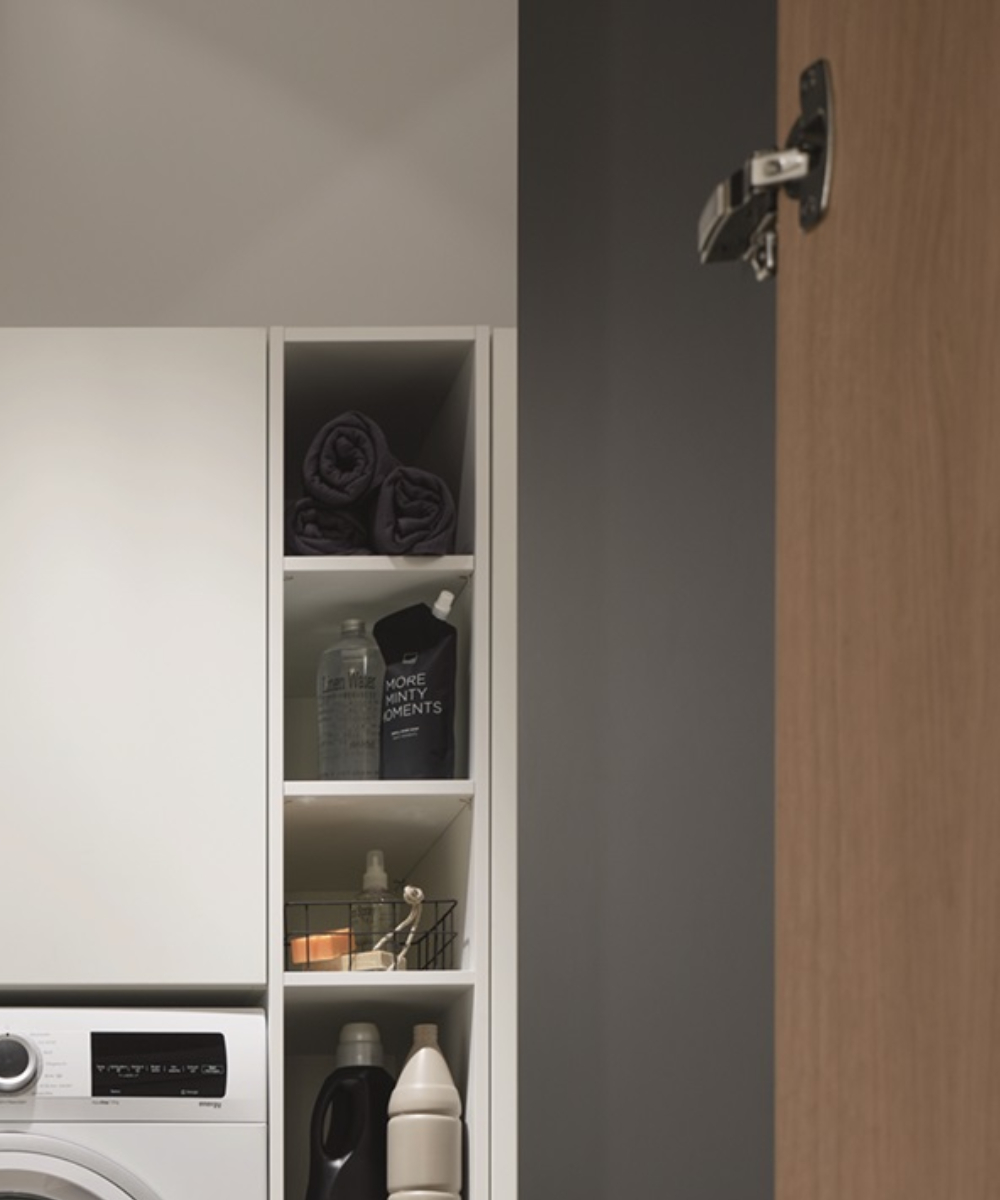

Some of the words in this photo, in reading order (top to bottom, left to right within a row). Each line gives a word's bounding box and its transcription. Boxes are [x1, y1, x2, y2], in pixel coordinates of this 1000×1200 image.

[386, 672, 427, 691] MORE
[385, 686, 428, 706] MINTY
[383, 700, 443, 723] OMENTS
